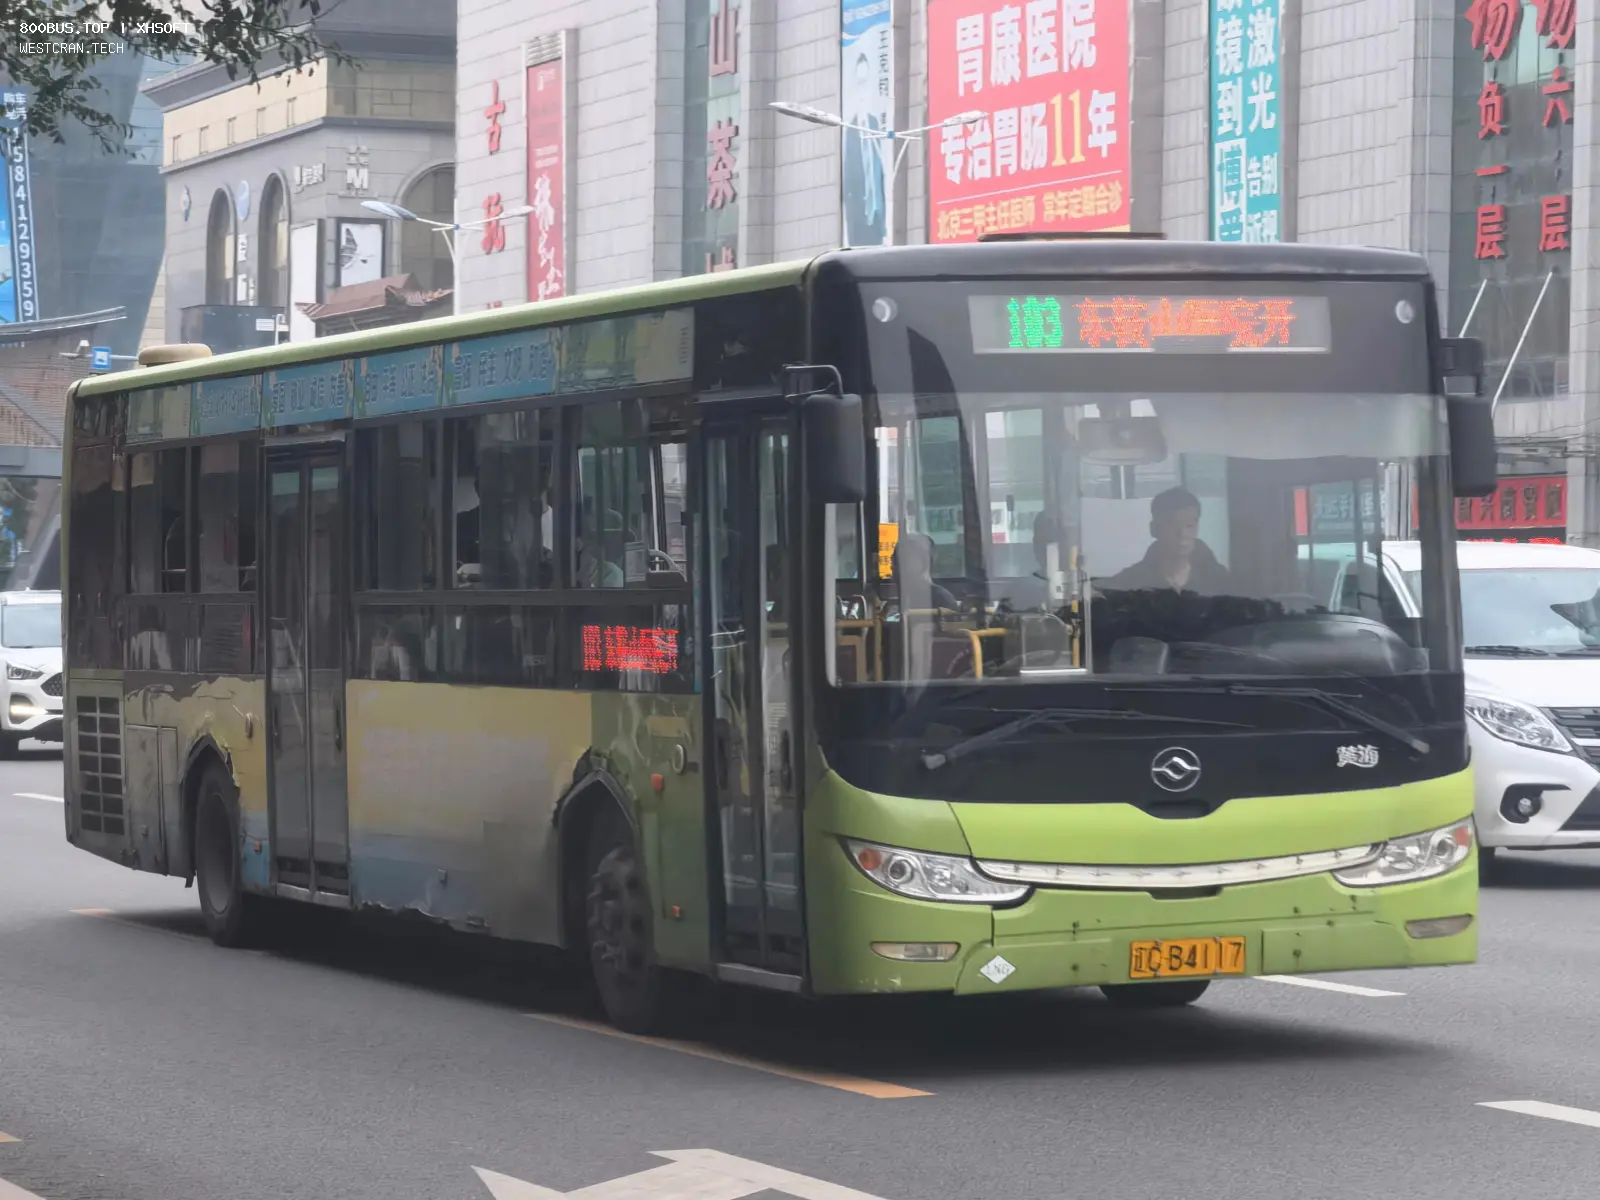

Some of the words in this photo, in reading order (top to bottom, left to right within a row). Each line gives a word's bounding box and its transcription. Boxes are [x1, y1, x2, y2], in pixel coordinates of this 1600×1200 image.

[955, 0, 1097, 97] 胃康医院
[1215, 0, 1244, 136] 镜到
[1246, 0, 1277, 133] 激光
[940, 89, 1117, 185] 专治胃肠11年
[12, 126, 35, 321] 1584129359
